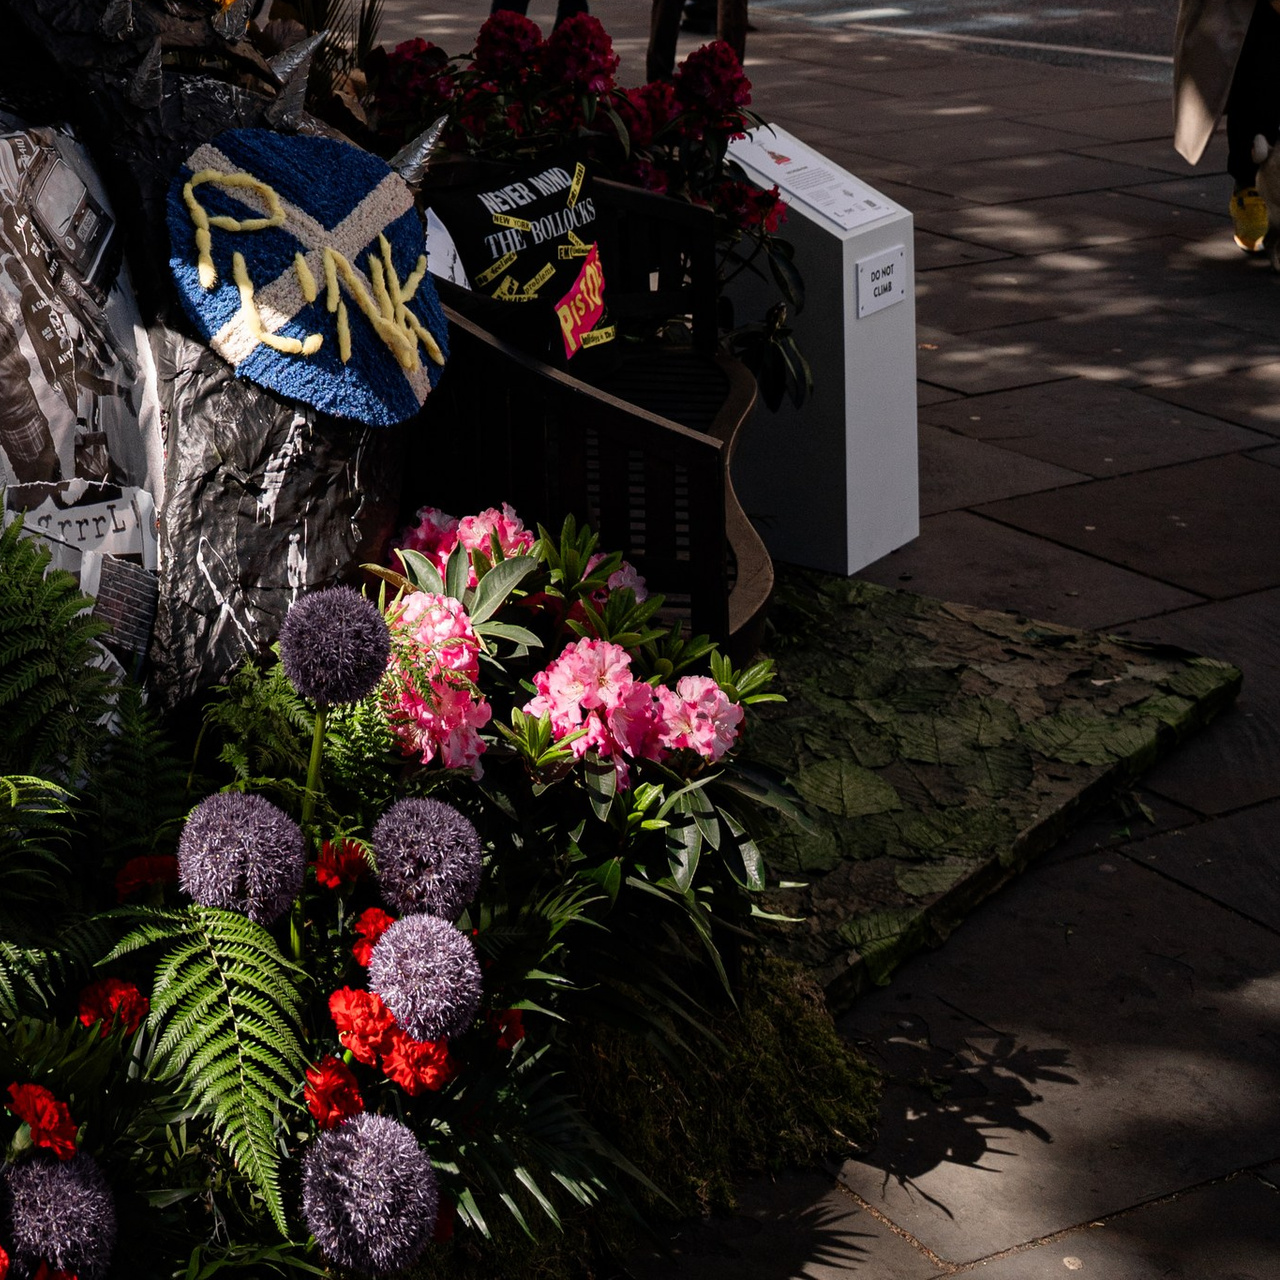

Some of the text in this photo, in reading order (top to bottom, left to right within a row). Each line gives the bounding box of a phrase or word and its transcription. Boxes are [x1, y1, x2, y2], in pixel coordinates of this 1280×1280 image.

[476, 181, 538, 216] NEVER
[527, 166, 574, 198] MIND
[484, 226, 528, 260] THE
[530, 197, 597, 246] BOLLOCKS
[493, 215, 531, 231] NEW YORK
[181, 168, 447, 373] PUNK
[870, 263, 895, 283] DO NOT
[872, 280, 893, 299] CLIMB
[57, 349, 74, 366] ANT
